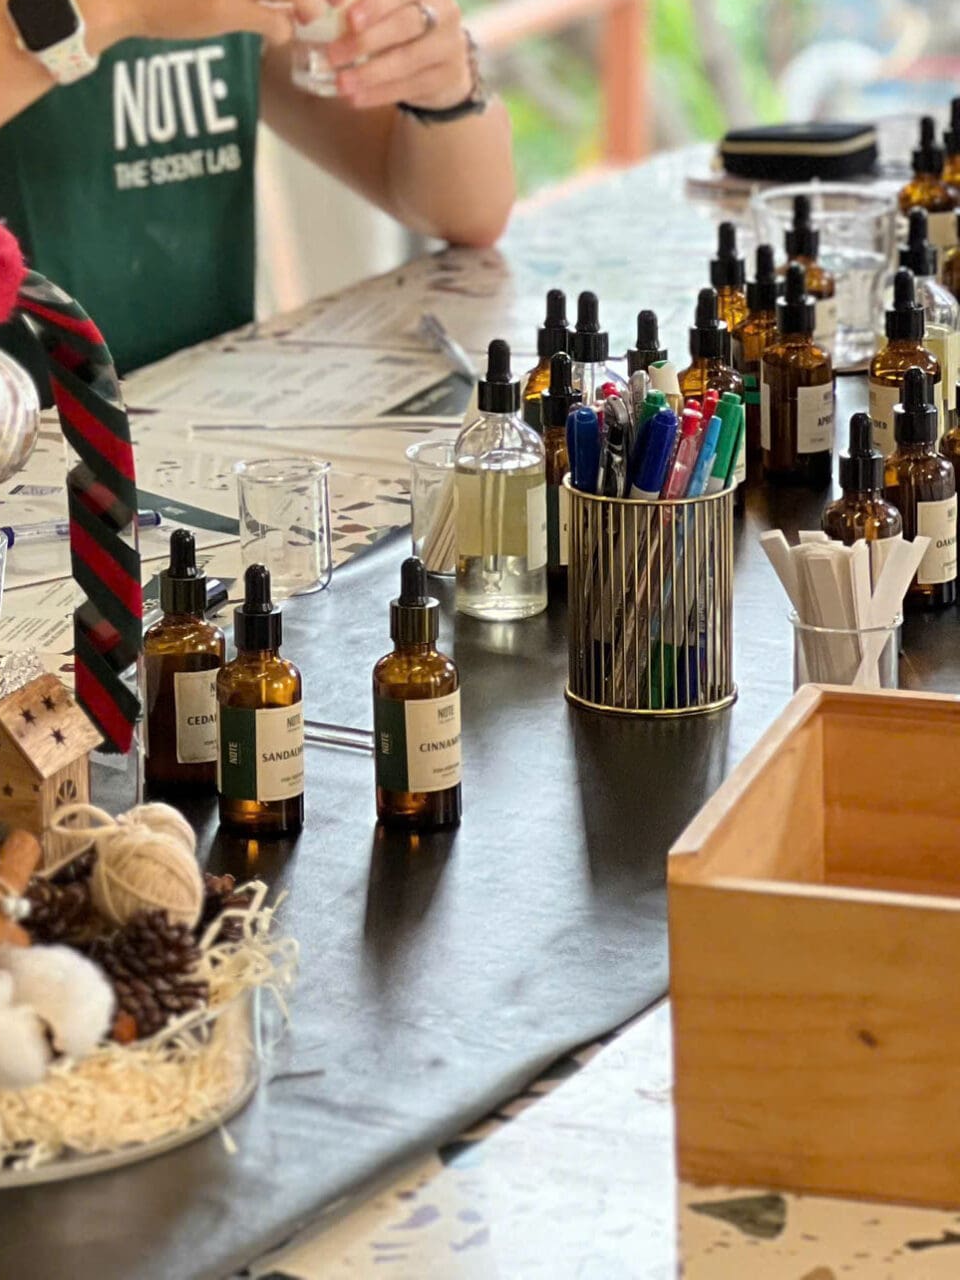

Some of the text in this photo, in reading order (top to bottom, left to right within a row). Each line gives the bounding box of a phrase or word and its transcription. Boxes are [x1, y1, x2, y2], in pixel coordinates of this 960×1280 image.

[114, 45, 238, 151] NOTE
[114, 143, 242, 190] THE SCENT LAB
[187, 714, 217, 726] CEDA
